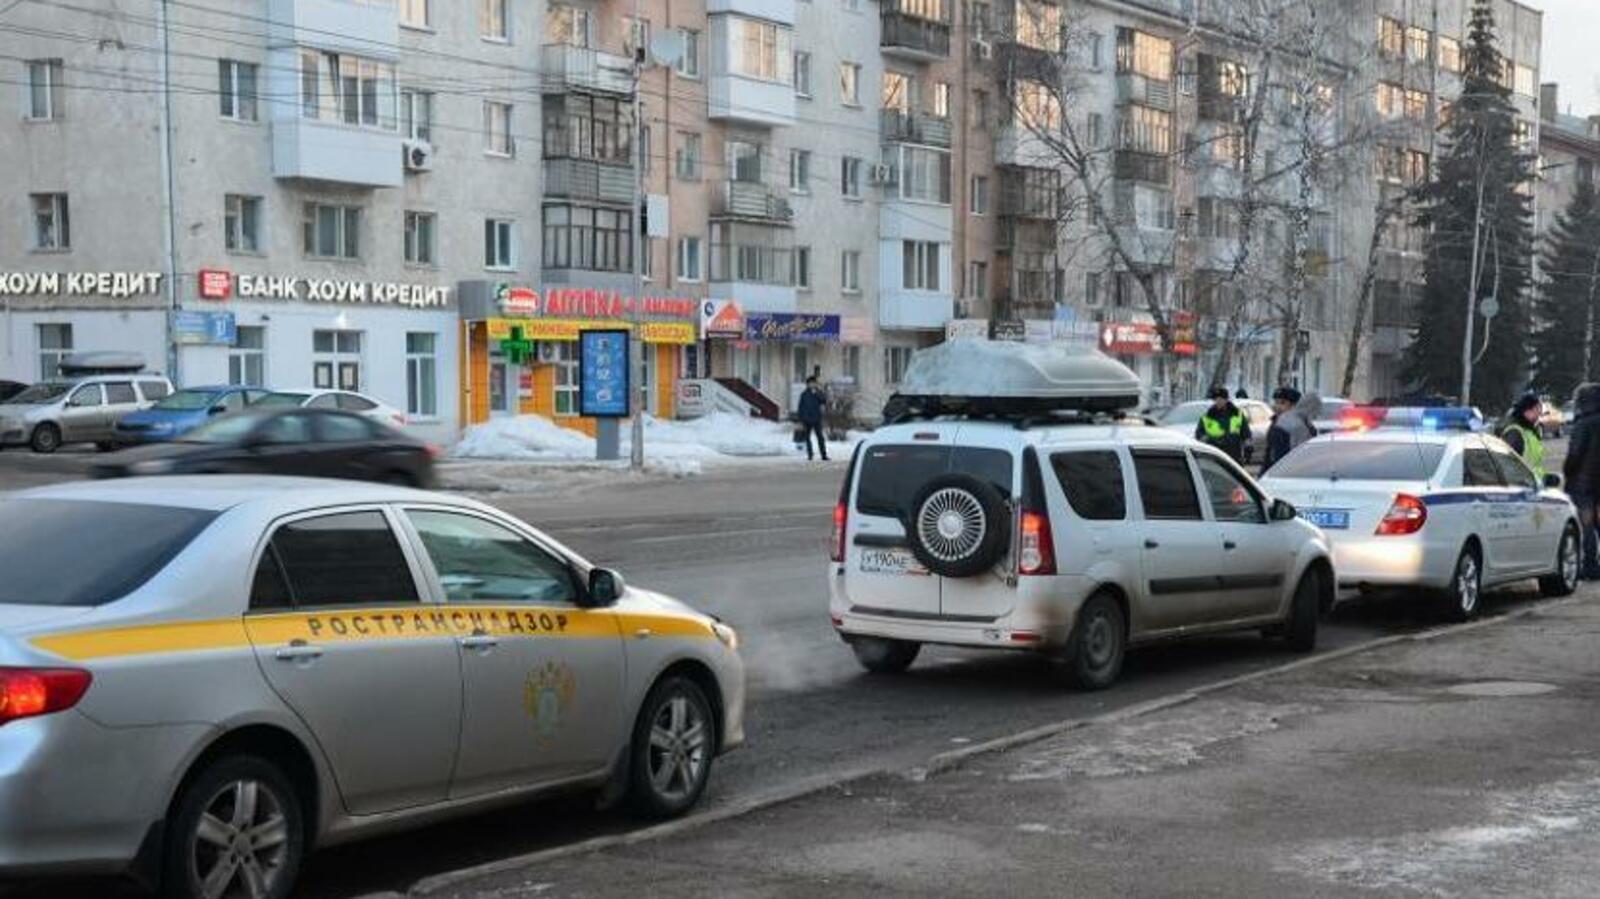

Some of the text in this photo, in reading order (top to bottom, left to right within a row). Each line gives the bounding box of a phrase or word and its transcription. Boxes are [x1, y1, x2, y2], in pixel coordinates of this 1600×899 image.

[67, 271, 163, 297] КРЕДИТ
[237, 274, 298, 298] БАНК
[306, 278, 366, 302] ХОУМ
[372, 282, 450, 306] КРЕДИТ
[544, 287, 623, 317] АПТЕКА
